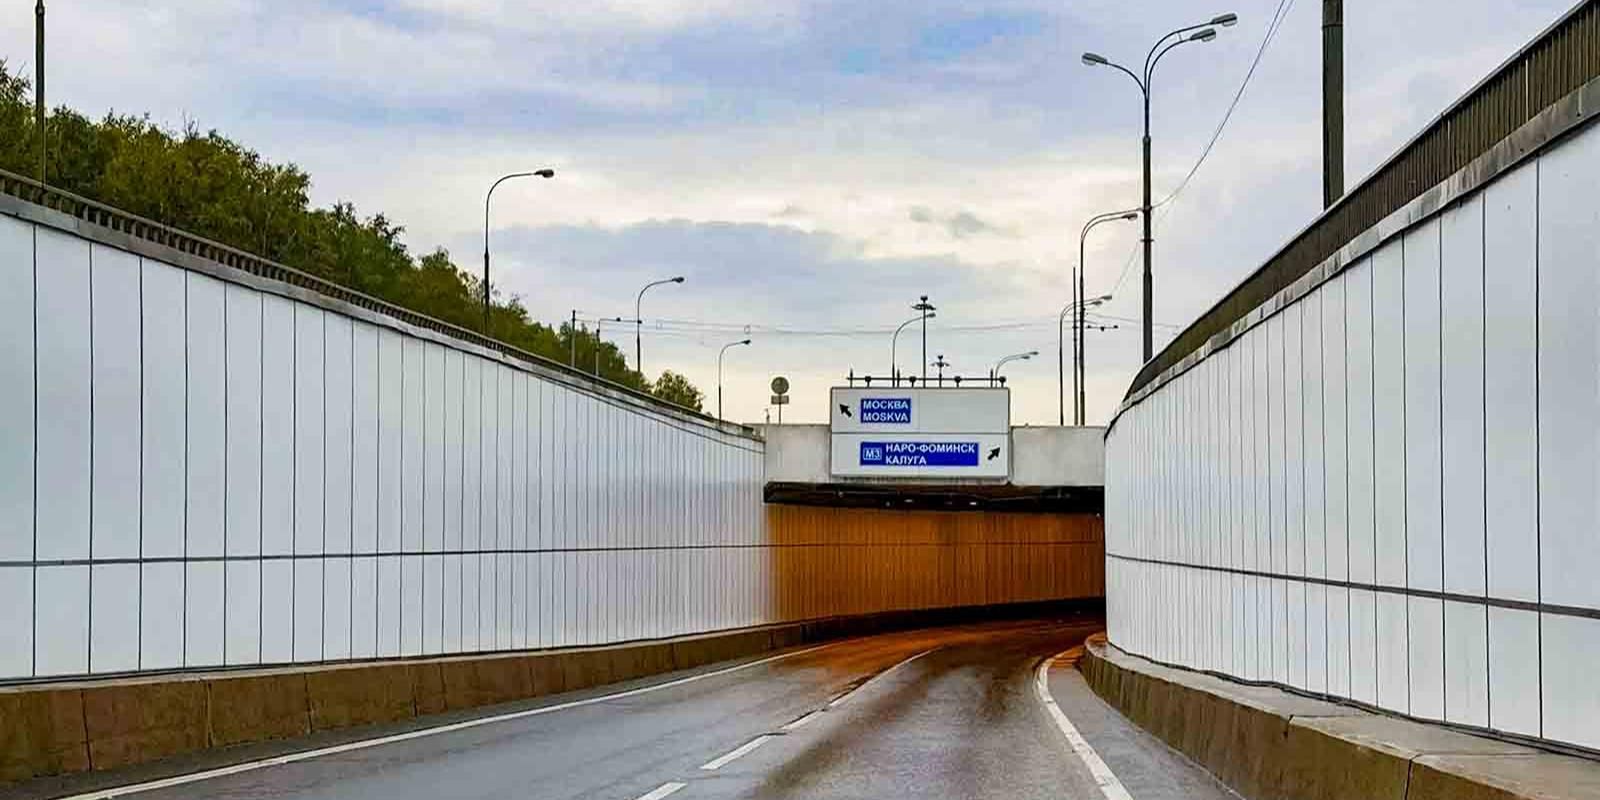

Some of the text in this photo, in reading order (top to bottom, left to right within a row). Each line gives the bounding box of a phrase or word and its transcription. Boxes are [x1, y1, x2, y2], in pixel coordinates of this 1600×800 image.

[863, 400, 909, 410] МОСКВА
[863, 412, 909, 421] MOSKVA
[885, 443, 975, 453] НАРО-ФОМИНСК
[885, 455, 927, 465] КАЛУГА
